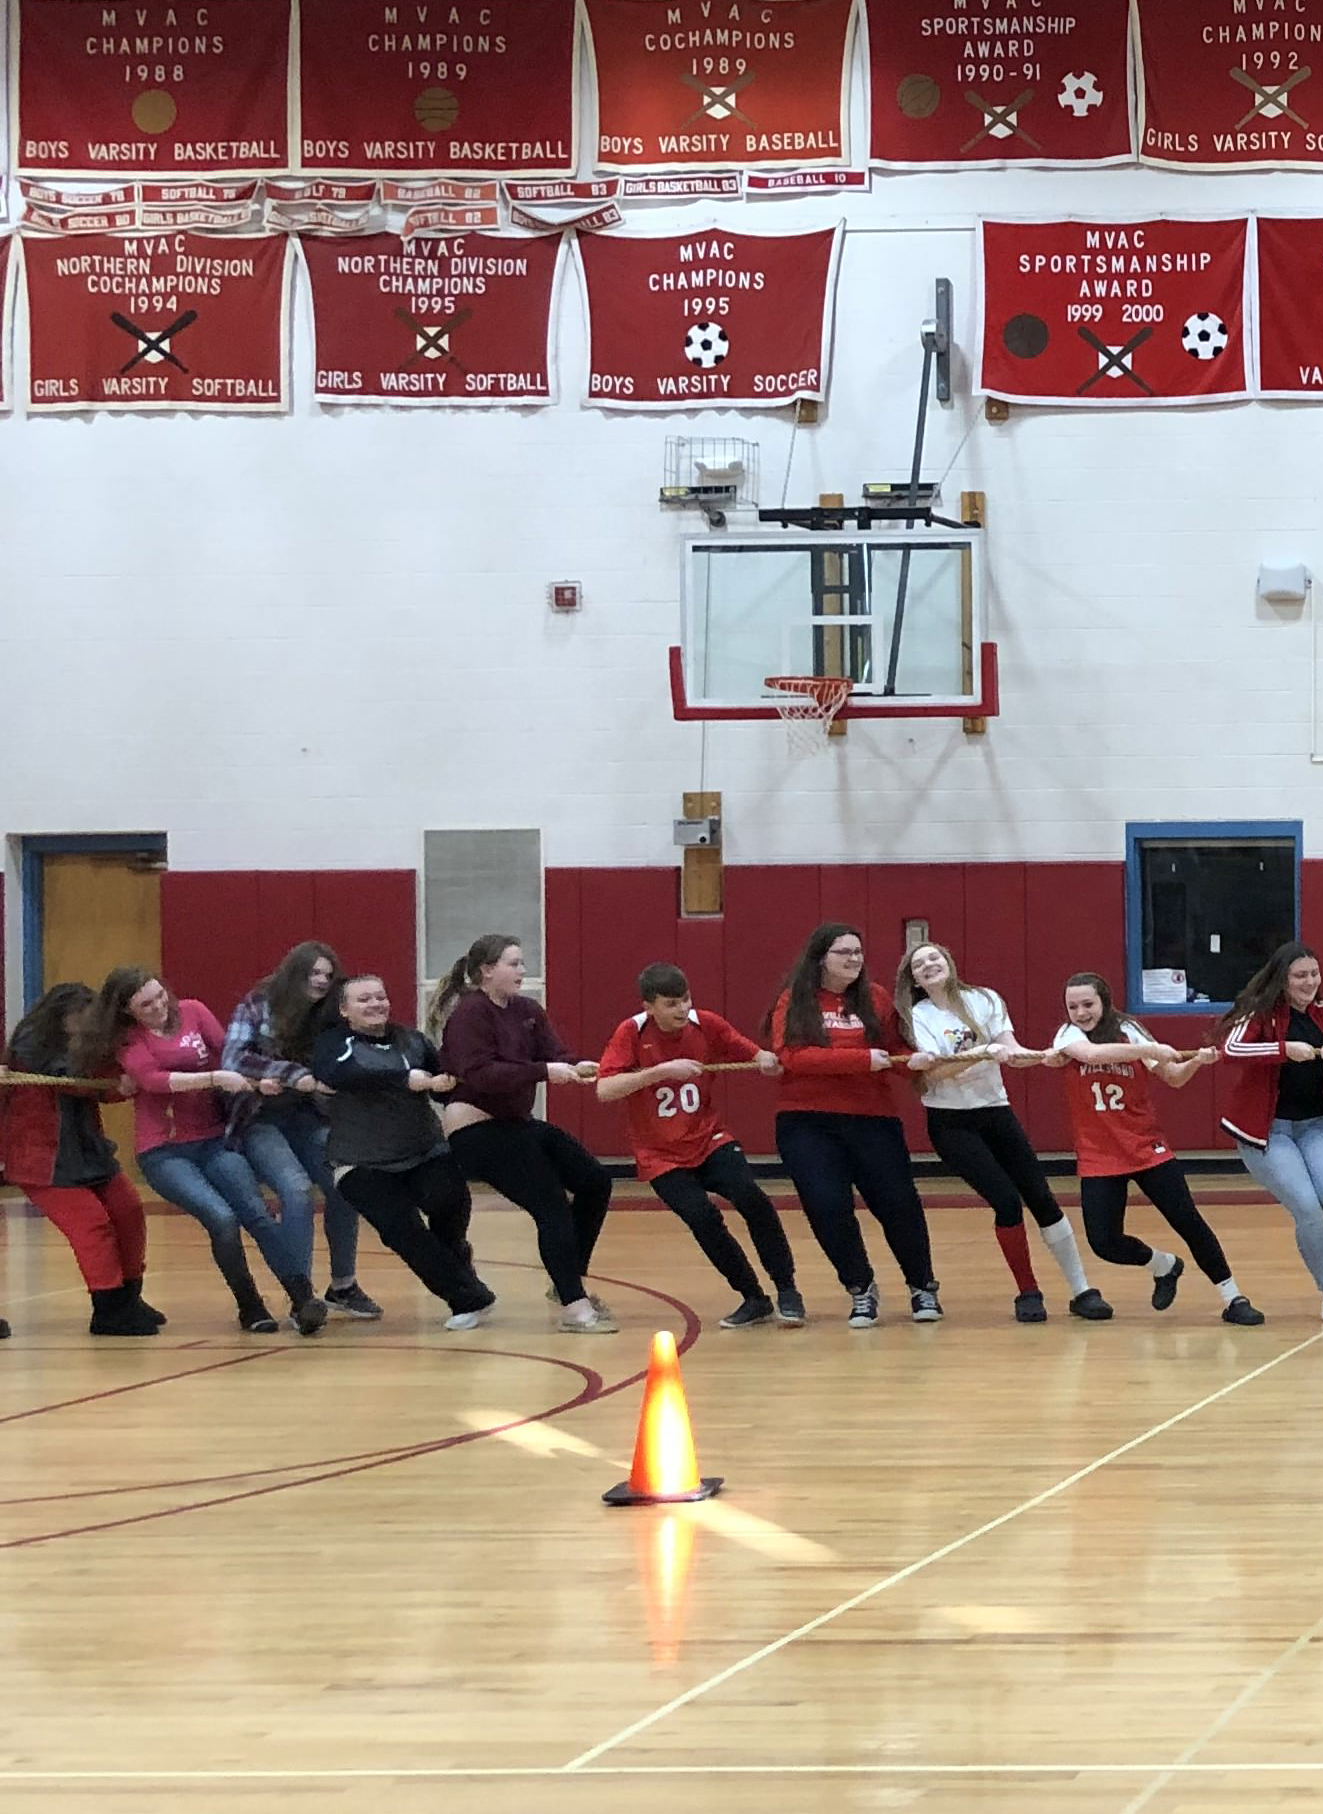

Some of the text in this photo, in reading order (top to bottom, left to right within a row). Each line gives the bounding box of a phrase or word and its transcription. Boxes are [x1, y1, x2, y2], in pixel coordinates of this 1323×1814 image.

[101, 8, 208, 27] MVAC
[384, 5, 491, 26] MVAC
[667, 0, 773, 26] MVAC
[921, 15, 1076, 36] SPORTSMANSHIP
[86, 35, 224, 55] CHAMPIONS
[368, 33, 507, 54] CHAMPIONS
[644, 28, 795, 52] COCHAMPIONS
[963, 39, 1034, 59] AWARD
[408, 61, 467, 81] 1989
[692, 56, 747, 76] 1989
[1242, 50, 1299, 71] 1992
[125, 64, 184, 83] 1988
[957, 62, 1041, 82] 1990-91
[303, 139, 569, 161] BOYS VARSITY BASKETBALL
[600, 130, 839, 155] BOYS VARSITY BASEBALL
[1146, 127, 1199, 152] GIRLS
[1212, 131, 1292, 152] VARSITY
[24, 140, 281, 161] BOYS VARSITY BASKETBALL
[517, 184, 575, 198] SOFTBALL
[626, 181, 656, 195] GIRLS
[657, 179, 721, 194] BASKETBALL
[768, 175, 826, 187] BASEBALL
[161, 186, 216, 200] SOFTBALL
[124, 234, 186, 256] MVAC
[402, 237, 464, 256] MVAC
[1086, 229, 1145, 250] MVAC
[679, 240, 735, 263] MVAC
[56, 254, 254, 277] NORTHERN DIVISION
[337, 254, 528, 277] NORTHERN DIVISION
[1019, 252, 1211, 274] SPORTSMANSHIP
[87, 274, 221, 295] COCHAMPIONS
[379, 274, 486, 295] CHAMPIONS
[648, 268, 765, 291] CHAMPIONS
[1079, 278, 1153, 298] AWARD
[130, 294, 177, 314] 1994
[411, 296, 456, 314] 1995
[684, 296, 730, 317] 1995
[1067, 303, 1164, 323] 1999 2000
[33, 376, 278, 397] GIRLS VARSITY SOFTBALL
[316, 370, 547, 392] GIRLS VARSITY SOFTBALL
[591, 369, 818, 396] BOYS VARSITY SOCCER
[656, 1083, 700, 1117] 20
[1091, 1082, 1126, 1111] 12
